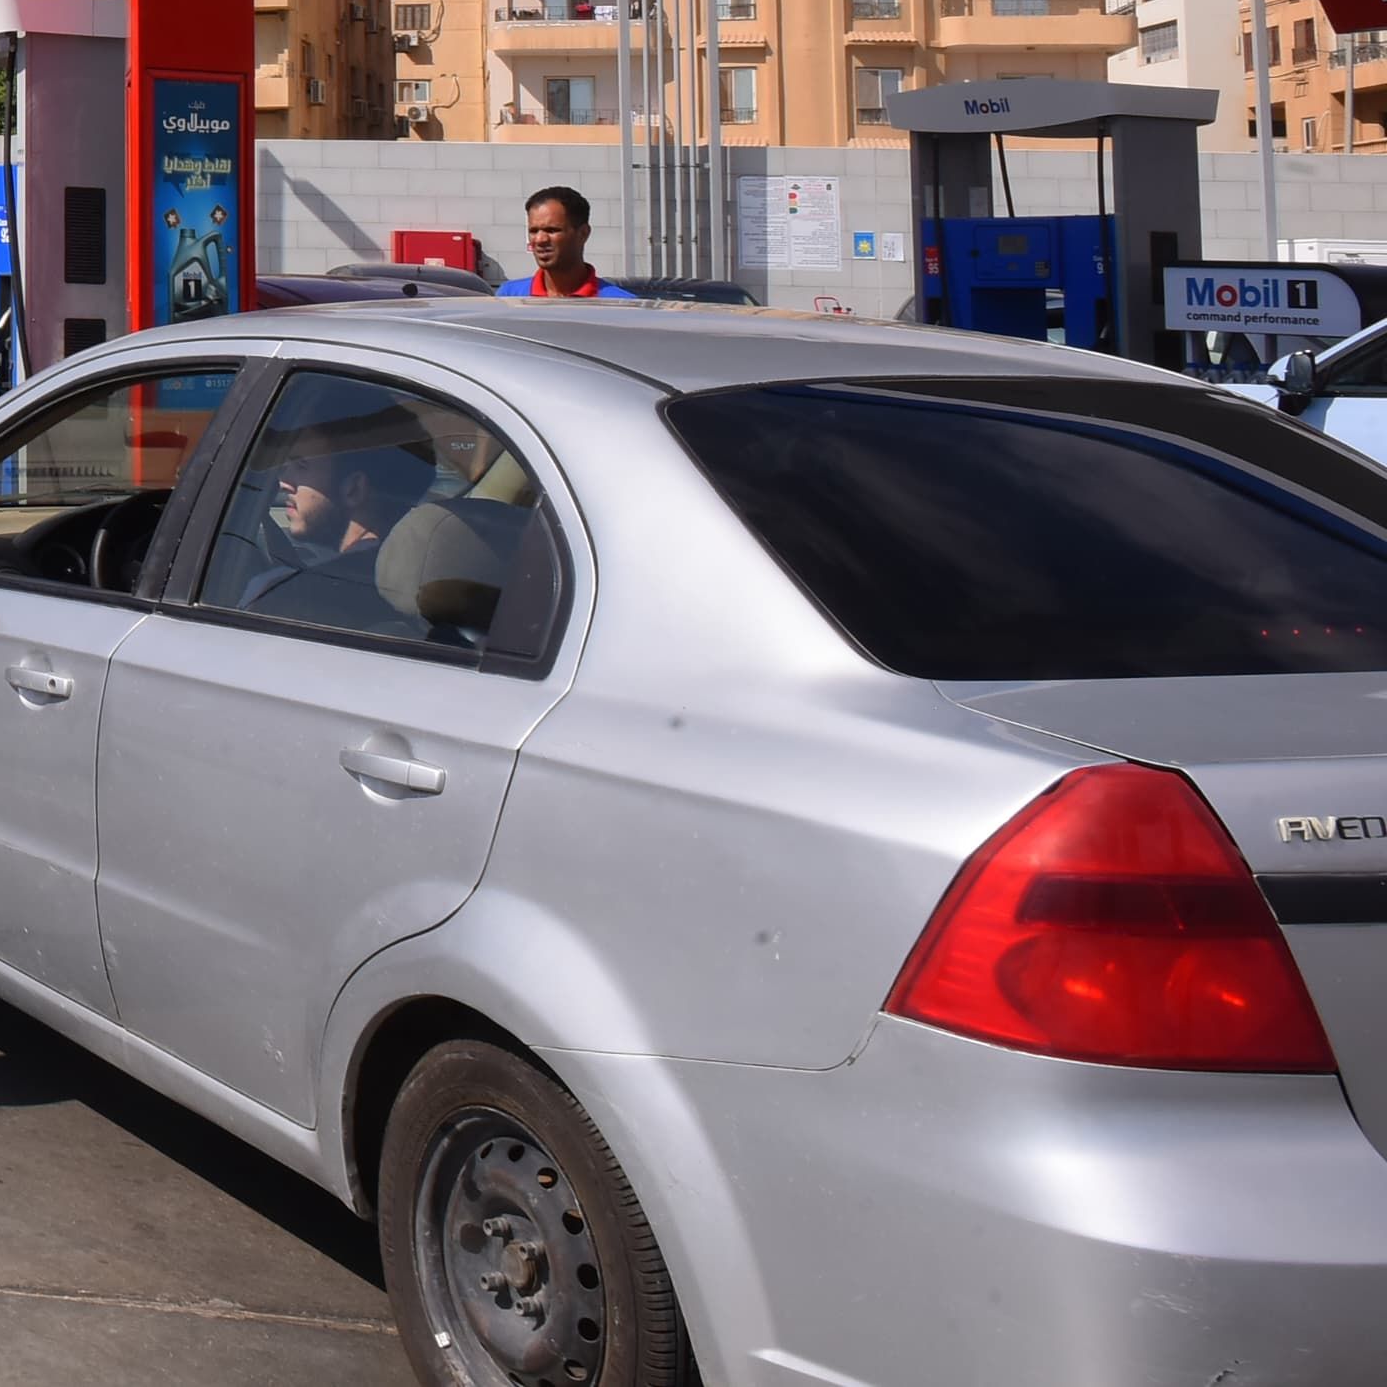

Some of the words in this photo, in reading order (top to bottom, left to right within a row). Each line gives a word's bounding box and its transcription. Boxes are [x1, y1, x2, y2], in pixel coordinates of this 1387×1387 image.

[964, 97, 1011, 115] Mobil
[1185, 277, 1280, 308] Mobil
[1186, 311, 1241, 322] command
[1244, 313, 1320, 326] performance
[1277, 816, 1387, 843] AVEO
